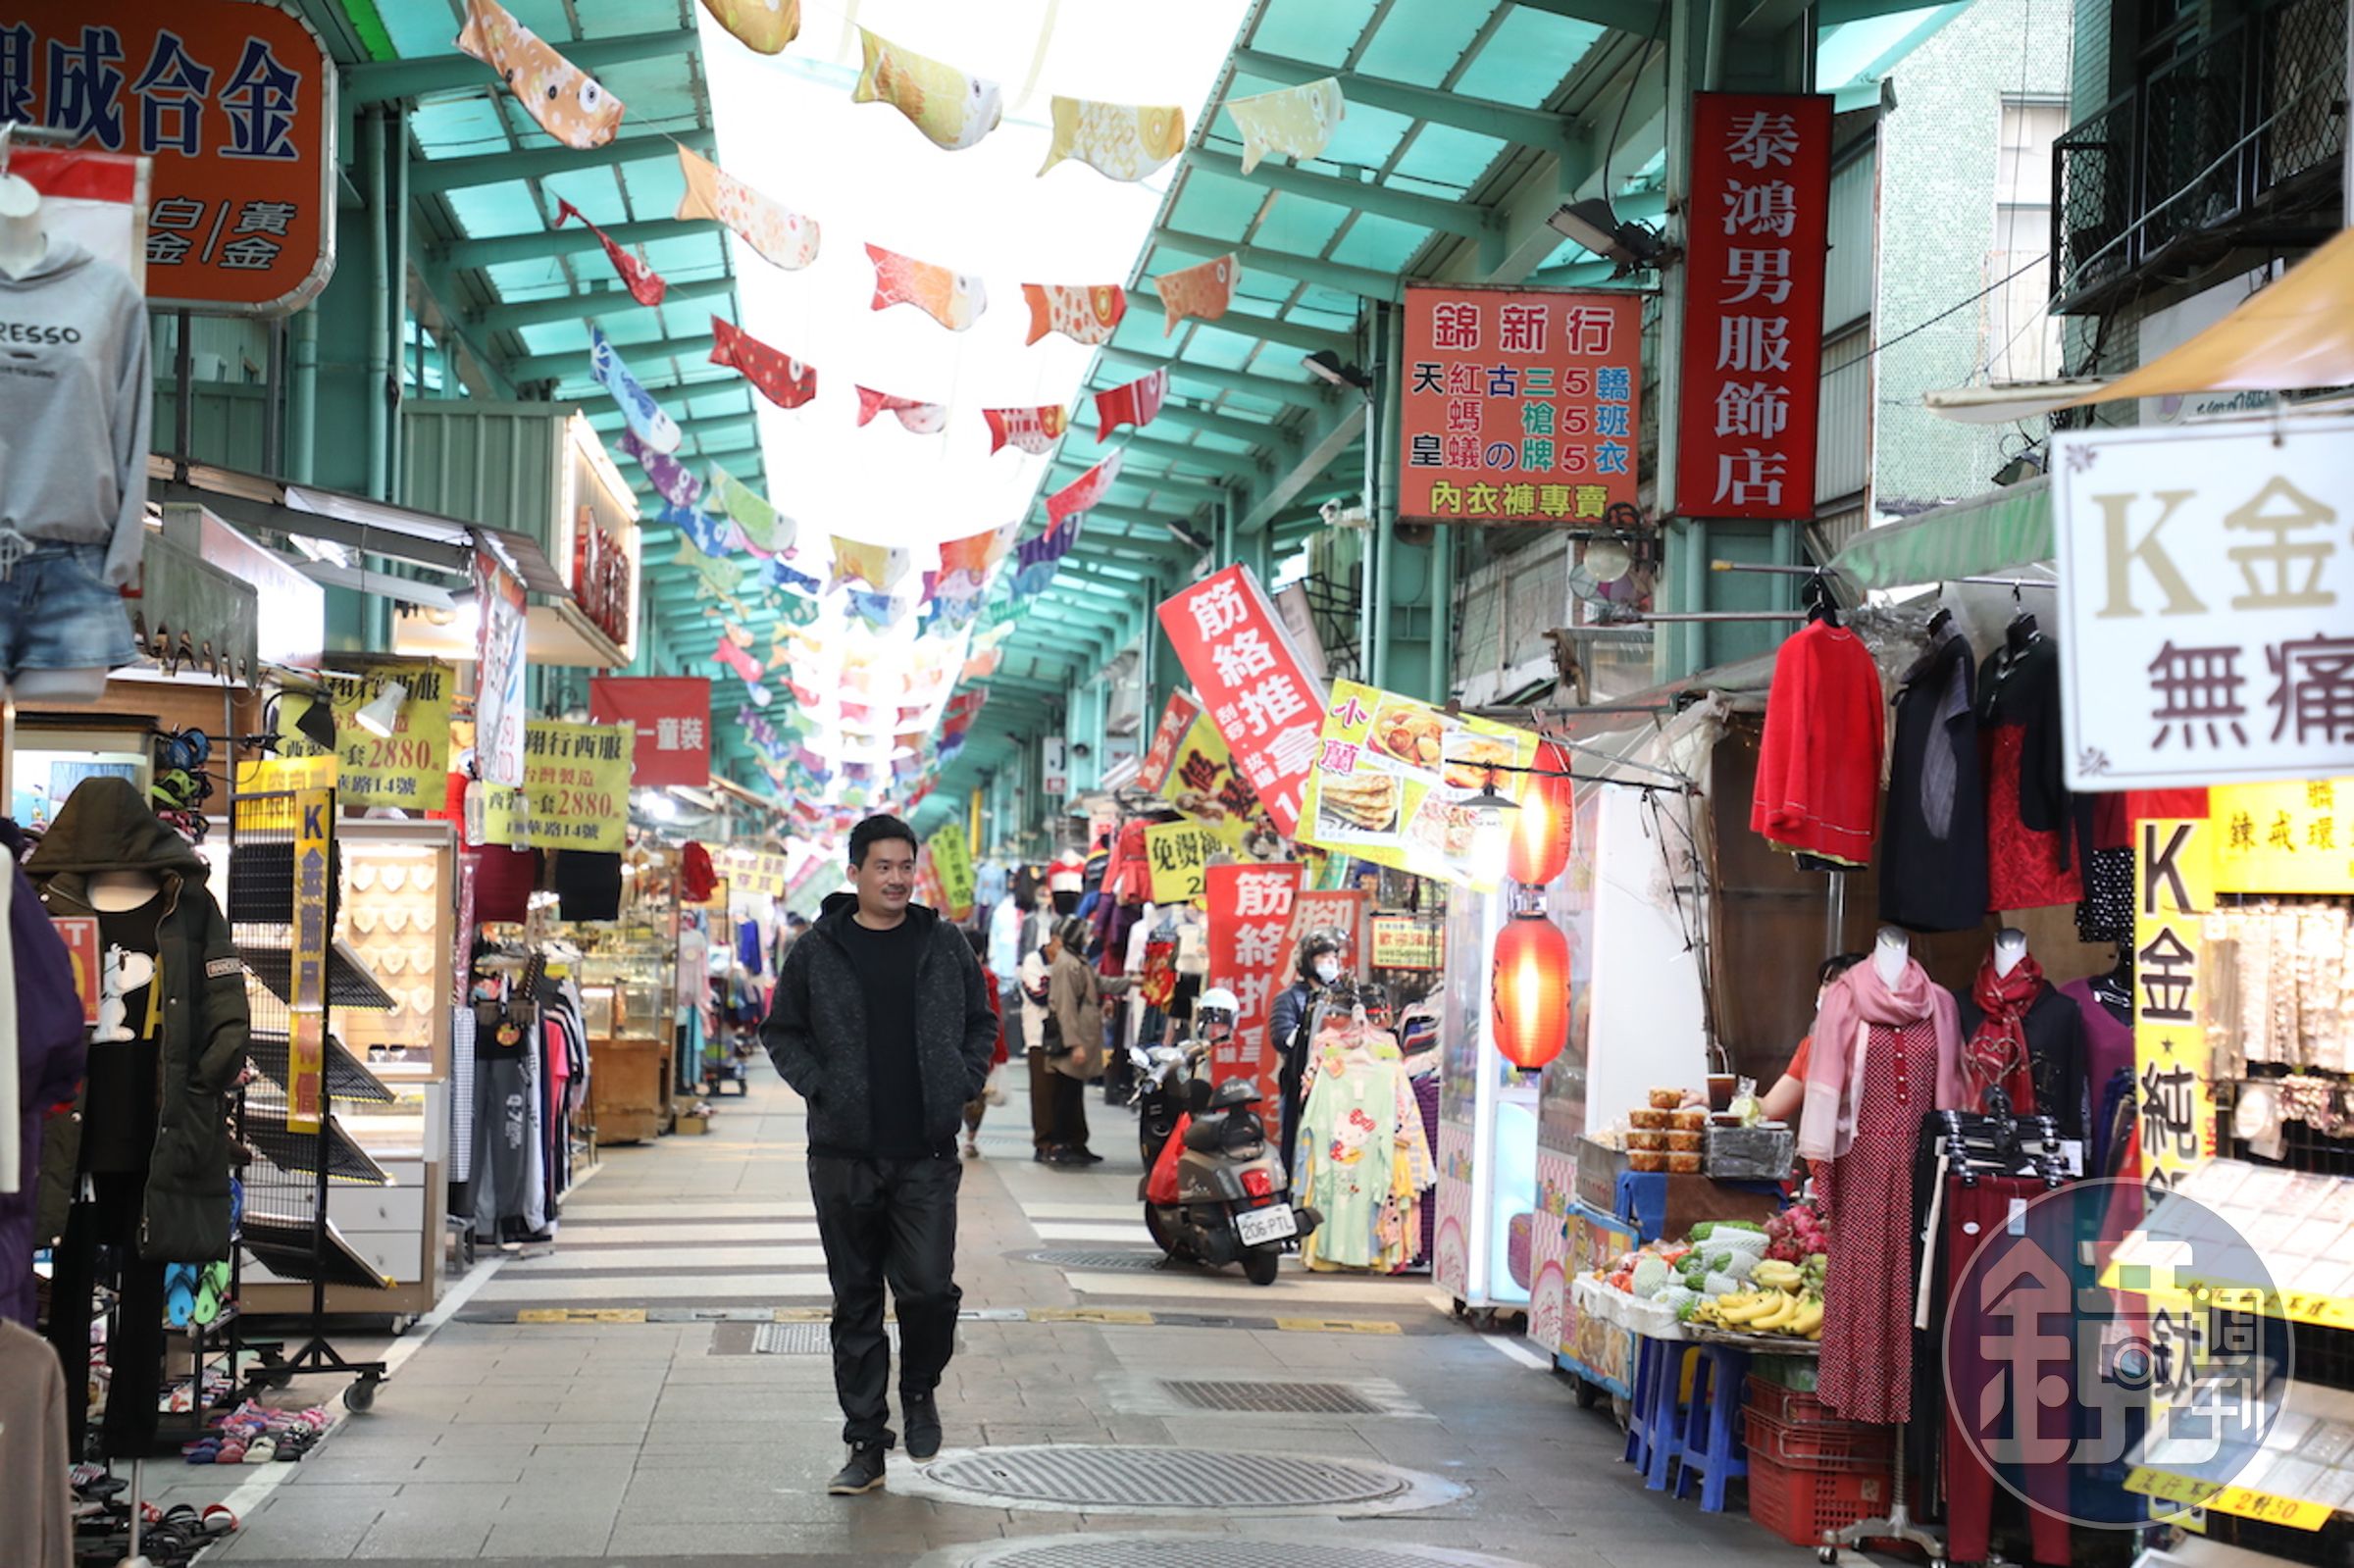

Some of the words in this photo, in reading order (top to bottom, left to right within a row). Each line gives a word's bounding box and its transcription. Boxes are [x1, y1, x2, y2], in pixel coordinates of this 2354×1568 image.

[1433, 302, 1614, 354] 錦新行
[1712, 111, 1799, 506] 泰鴻男服飾店
[2092, 476, 2354, 619] K金
[2148, 632, 2354, 749] 無痛
[507, 820, 599, 840] 華路14號
